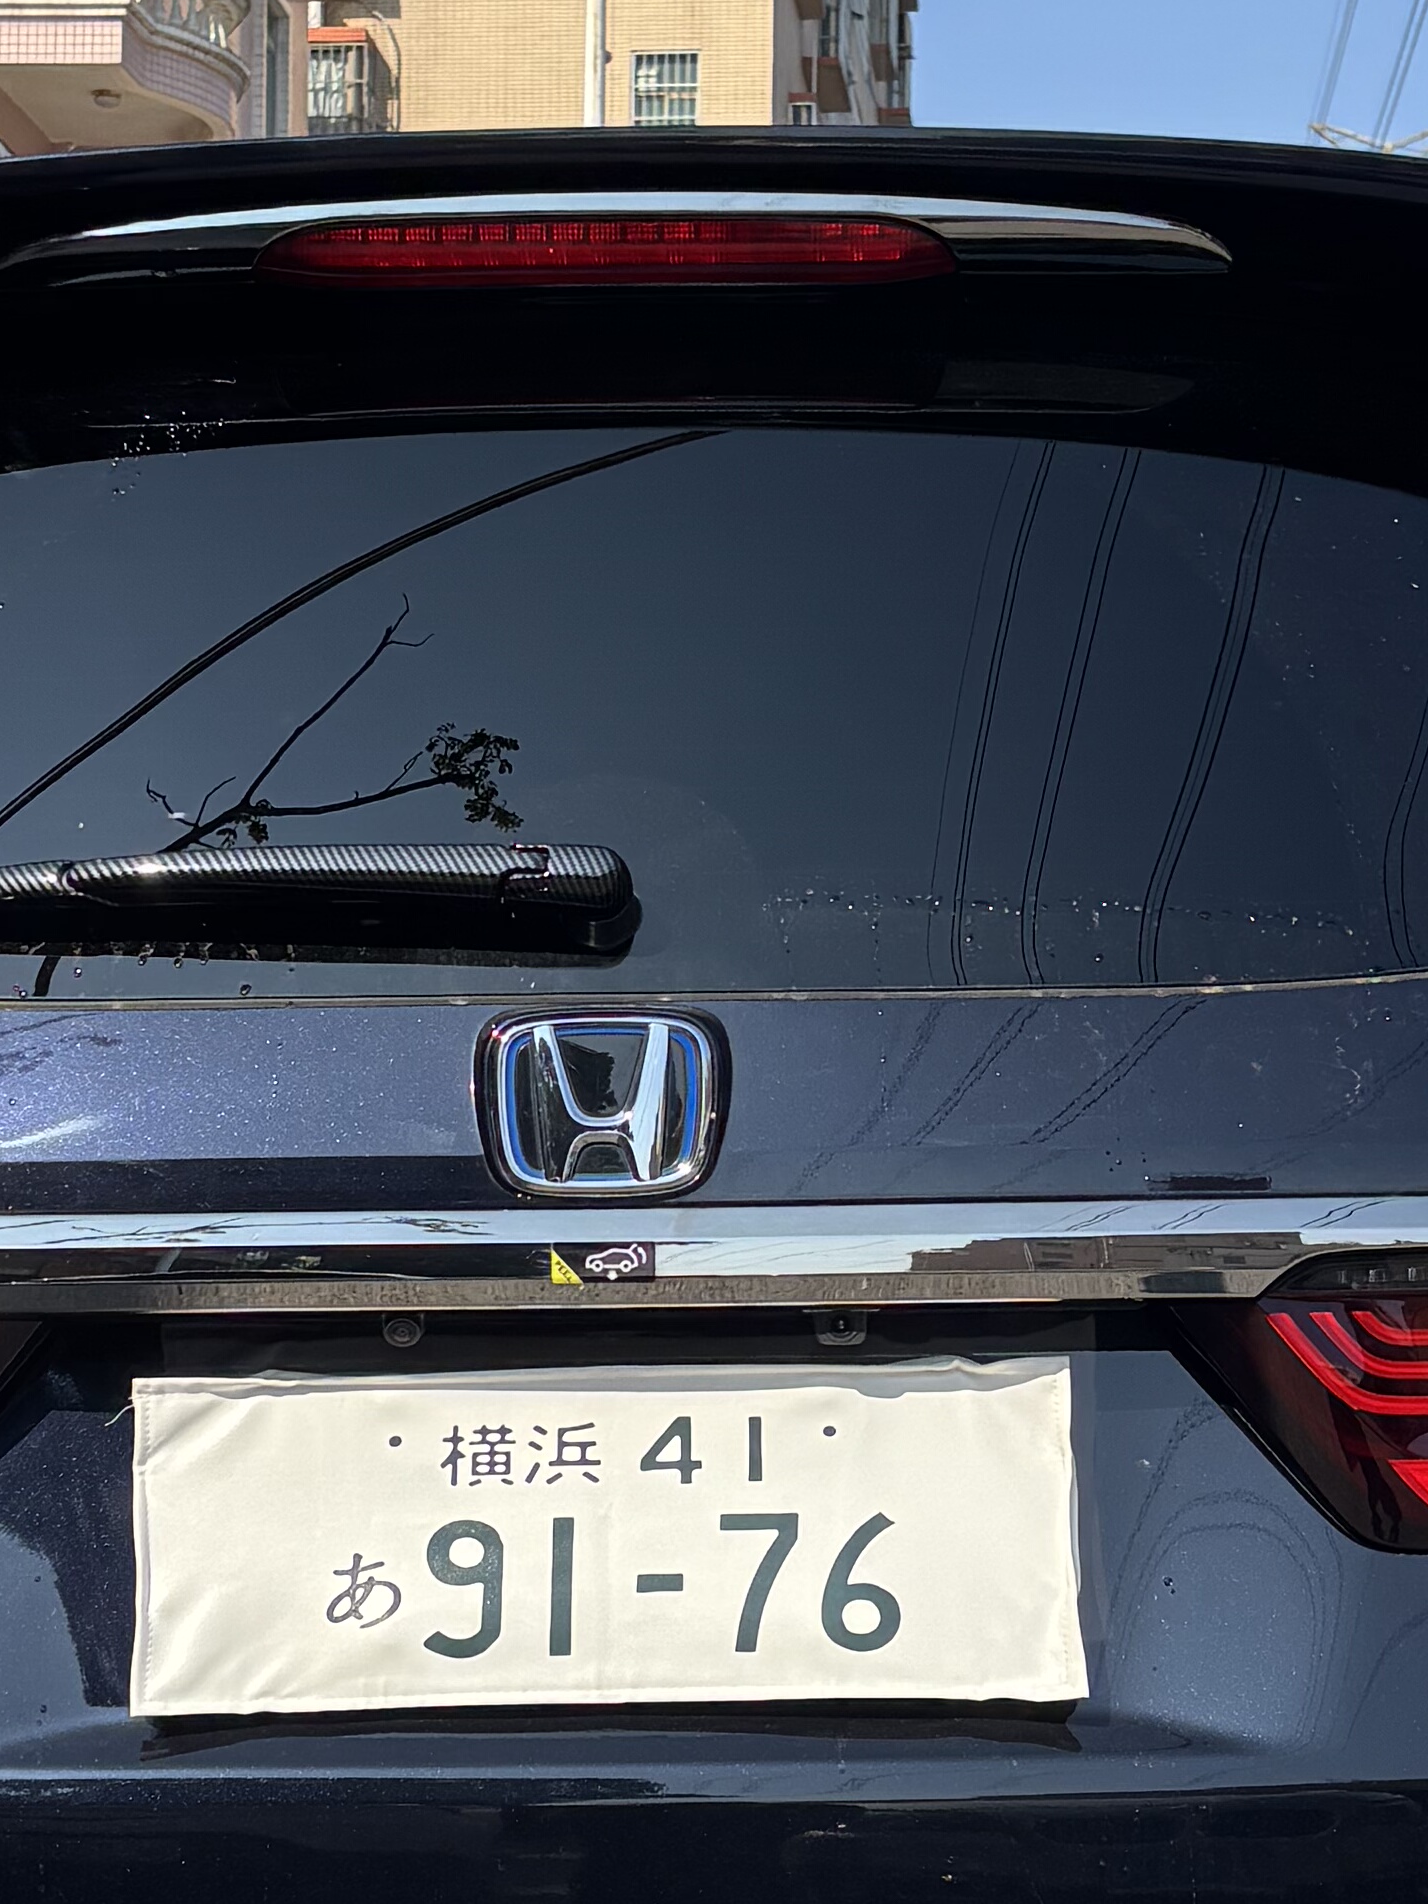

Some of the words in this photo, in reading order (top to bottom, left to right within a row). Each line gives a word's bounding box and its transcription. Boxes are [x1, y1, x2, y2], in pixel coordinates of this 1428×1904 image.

[440, 1423, 601, 1486] 横浜
[639, 1415, 764, 1484] 41
[324, 1553, 403, 1629] あ
[423, 1512, 901, 1659] 91-76
